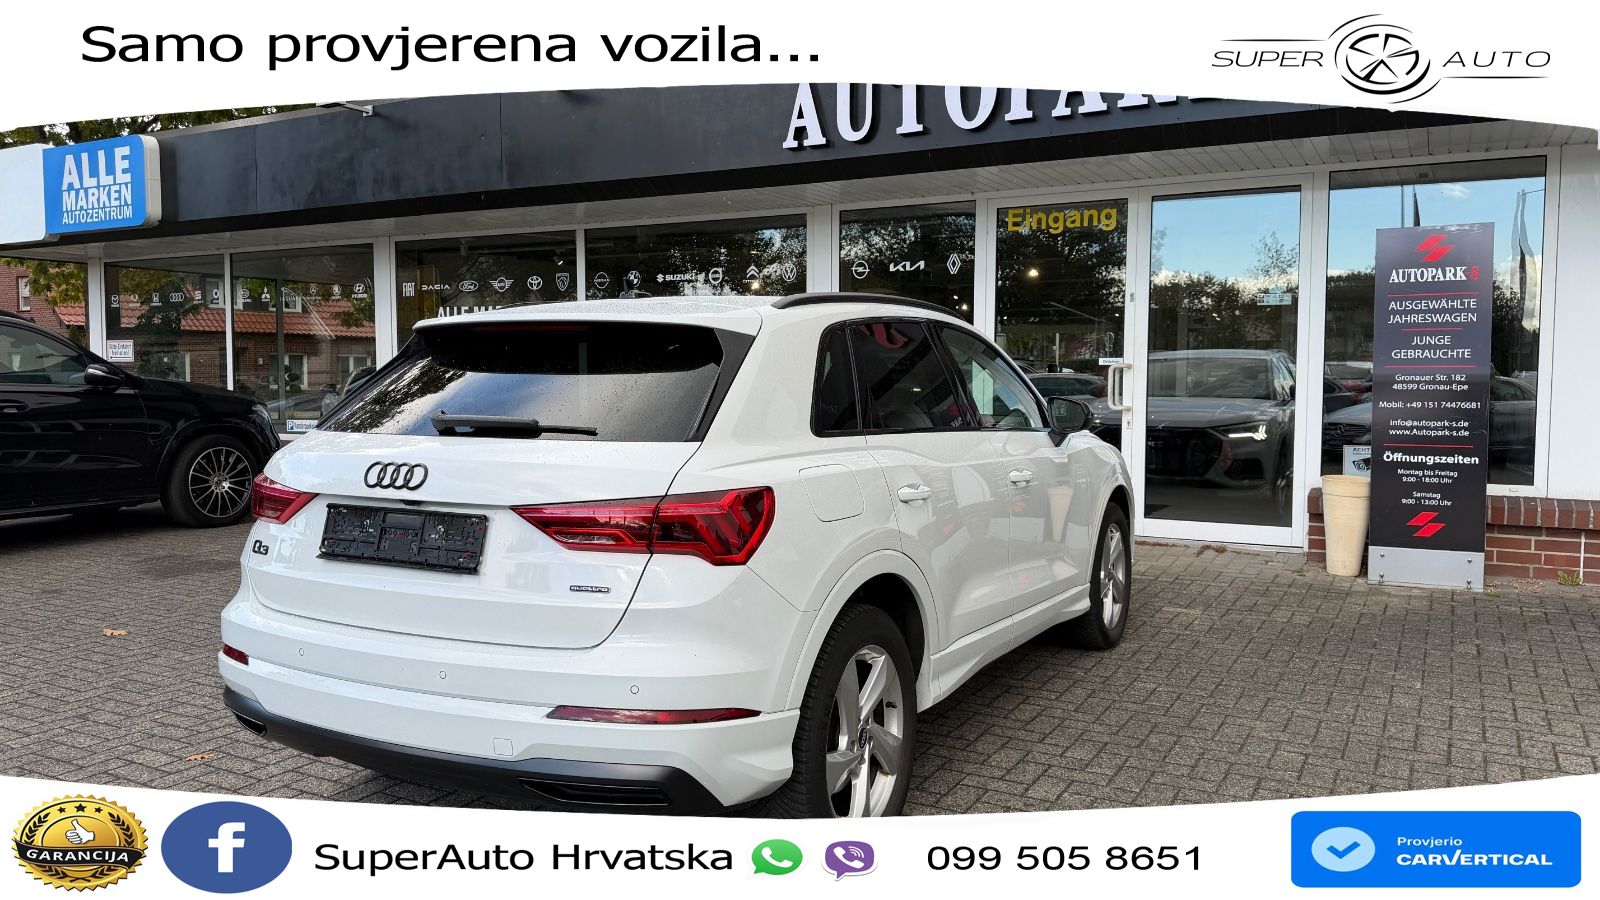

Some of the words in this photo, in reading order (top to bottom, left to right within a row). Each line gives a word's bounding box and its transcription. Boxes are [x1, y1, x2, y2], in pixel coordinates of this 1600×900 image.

[62, 146, 132, 190] ALLE
[62, 183, 132, 212] MARKEN
[62, 206, 133, 225] AUTOZENTRUM
[1007, 208, 1118, 234] Eingang
[665, 273, 696, 281] SUZUKI
[1388, 298, 1477, 310] AUSGEWÄHLTE
[1387, 312, 1477, 324] JAHRESWAGEN
[1411, 335, 1452, 345] JUNGE
[1391, 348, 1472, 359] GEBRAUCHTE
[1395, 373, 1434, 381] Gronauer
[1435, 373, 1449, 381] Str.
[1392, 383, 1418, 391] 48599
[1419, 383, 1469, 391] Gronau-Epe
[1379, 400, 1405, 408] Mobil:
[1440, 401, 1481, 409] 74476681
[1388, 428, 1470, 437] www.Autopark-s.de
[1383, 450, 1480, 465] Öffnungszeiten
[1397, 468, 1423, 477] Montag
[1435, 469, 1458, 478] Freitag
[1421, 476, 1439, 484] 18:00
[1412, 491, 1441, 499] Samstag
[1421, 498, 1439, 506] 13:00
[252, 539, 270, 556] Q3
